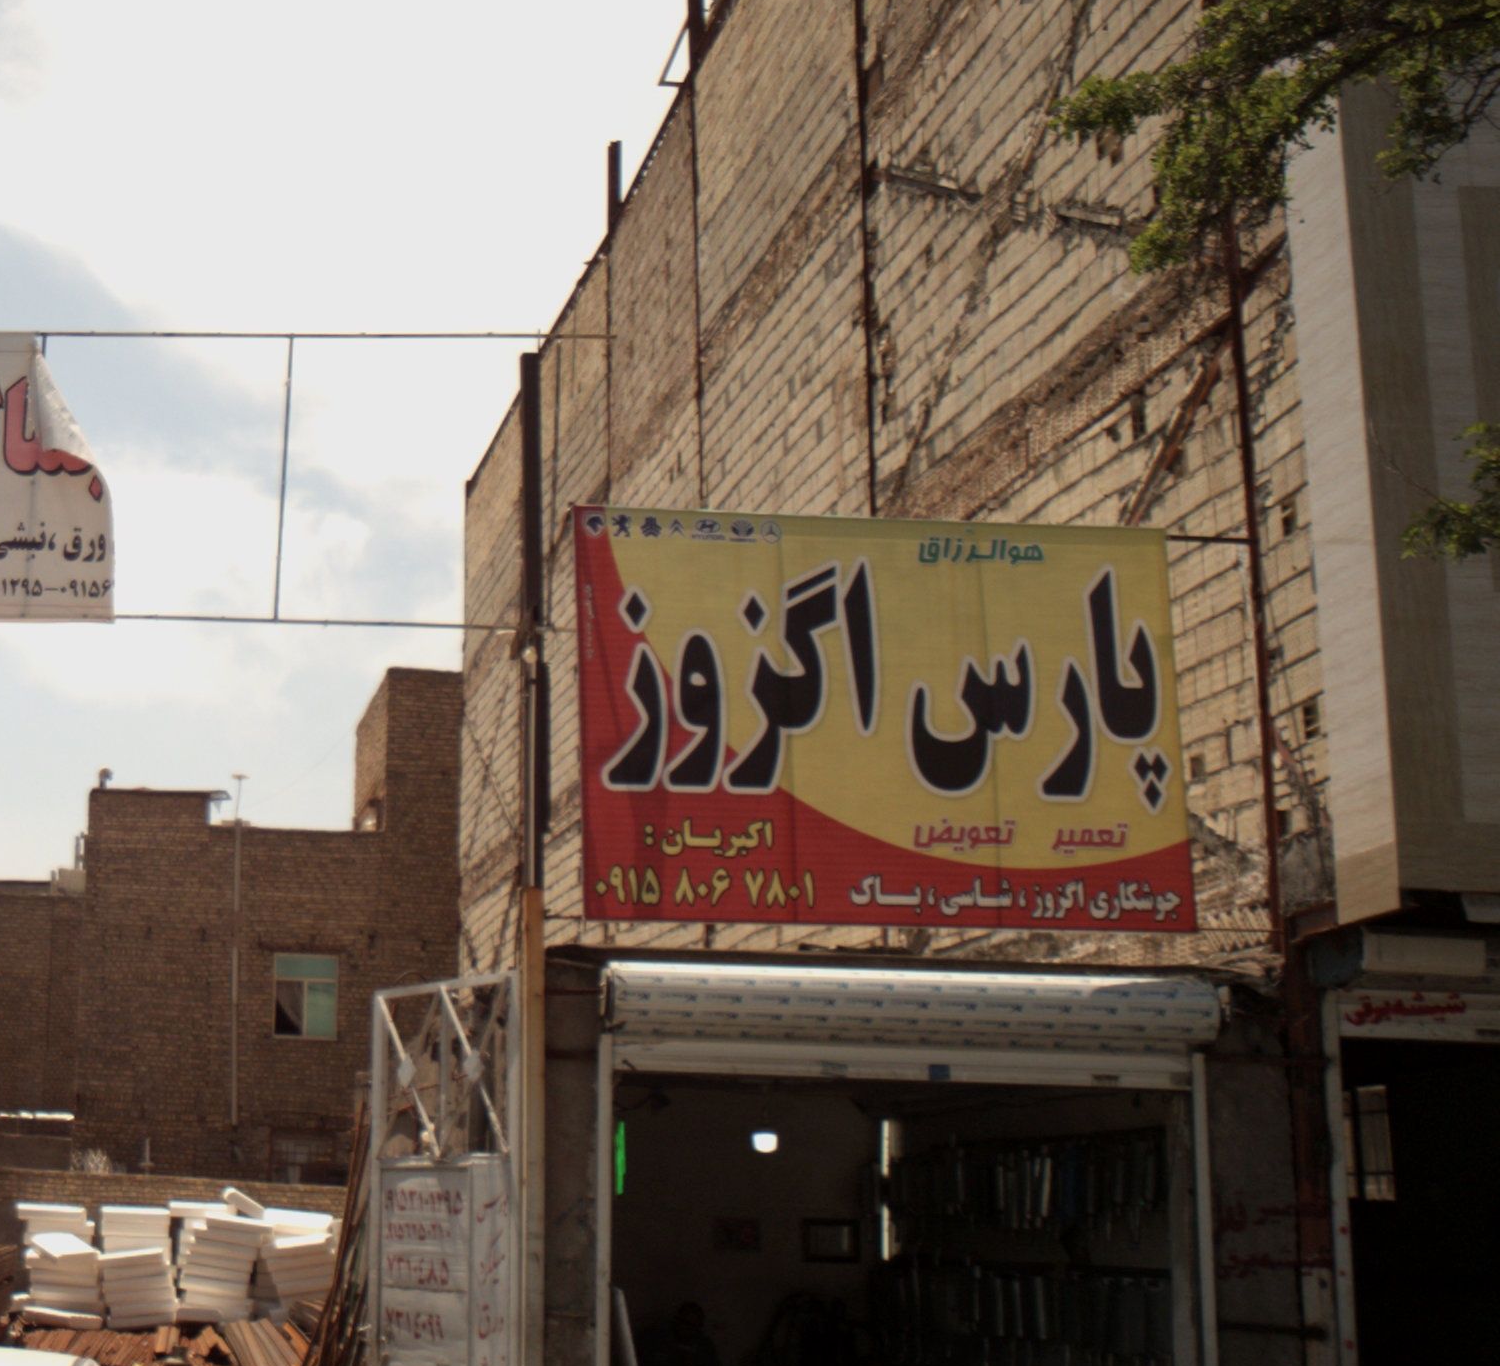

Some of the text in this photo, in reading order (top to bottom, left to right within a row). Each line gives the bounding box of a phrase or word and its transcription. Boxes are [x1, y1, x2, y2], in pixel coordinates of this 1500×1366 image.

[63, 527, 107, 562] ورق
[604, 560, 1170, 812] پارس اگزوز
[914, 818, 1128, 855] تعمیر تعویض
[595, 864, 815, 908] ۰۹۱۵ ۸۰۶ ۷۸۰۱
[850, 874, 923, 914] باک
[1088, 880, 1182, 922] جوشکاری
